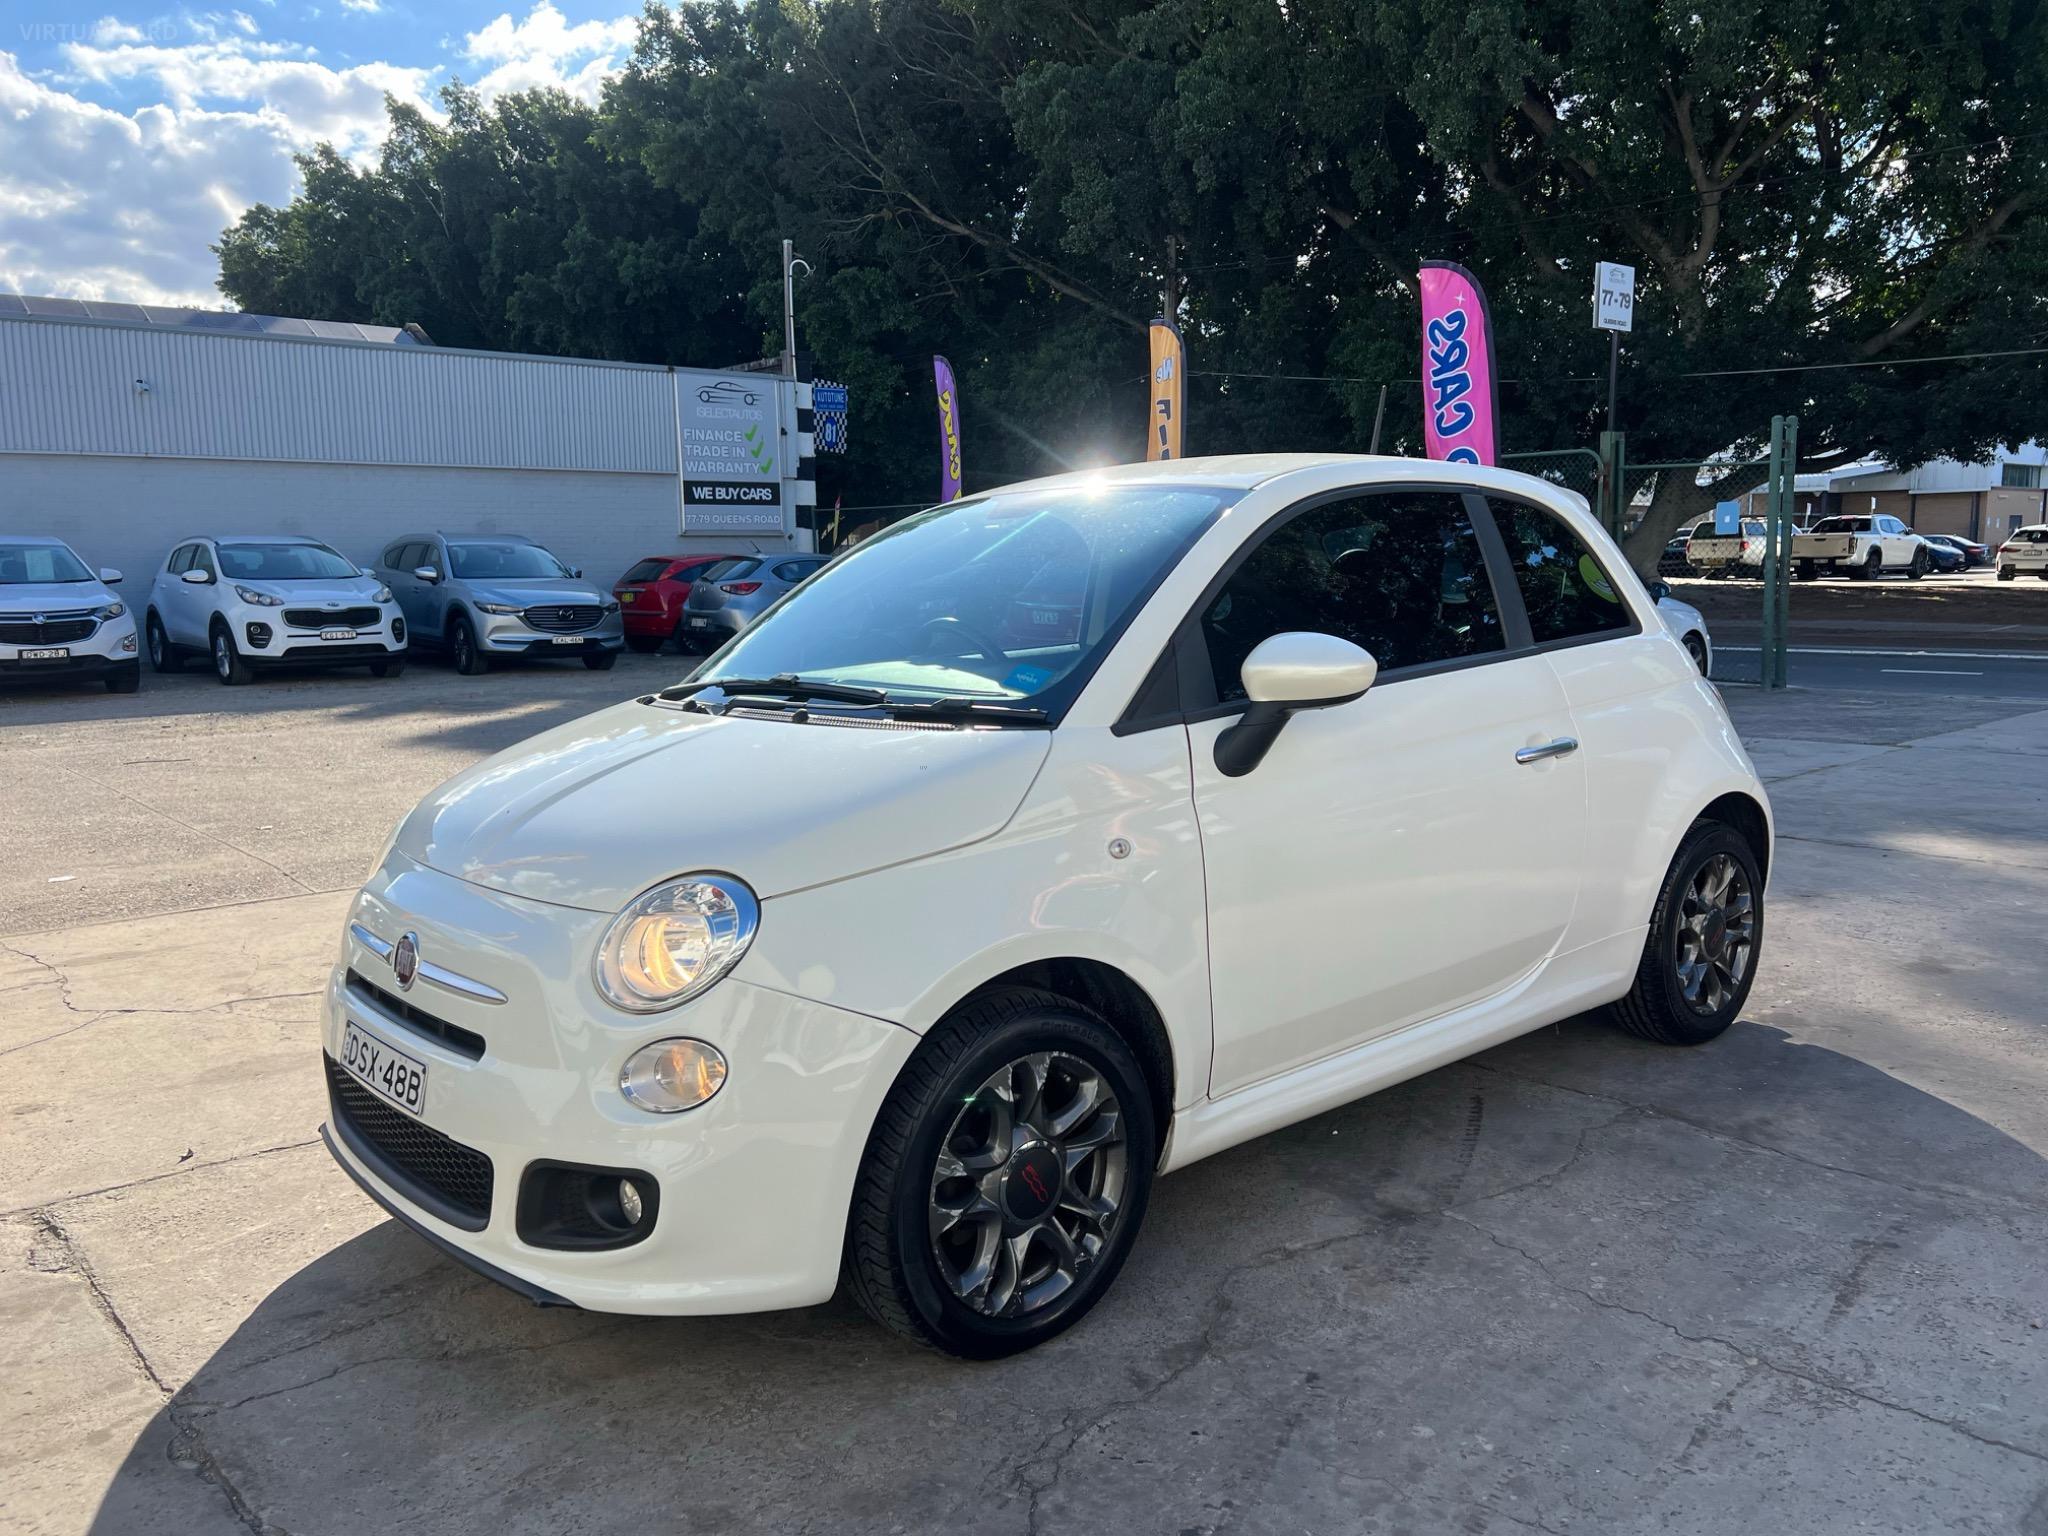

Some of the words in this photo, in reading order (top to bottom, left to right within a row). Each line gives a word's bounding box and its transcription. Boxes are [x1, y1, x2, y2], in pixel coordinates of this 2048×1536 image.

[683, 428, 742, 442] FINANCE
[825, 423, 837, 442] 81
[684, 444, 730, 457] TRADE
[732, 446, 746, 458] IN
[685, 460, 760, 474] WARRANTY
[692, 486, 713, 499] WE
[715, 487, 740, 500] BUY
[740, 487, 772, 501] CARS
[712, 514, 752, 524] QUEENS
[753, 515, 780, 524] ROAD
